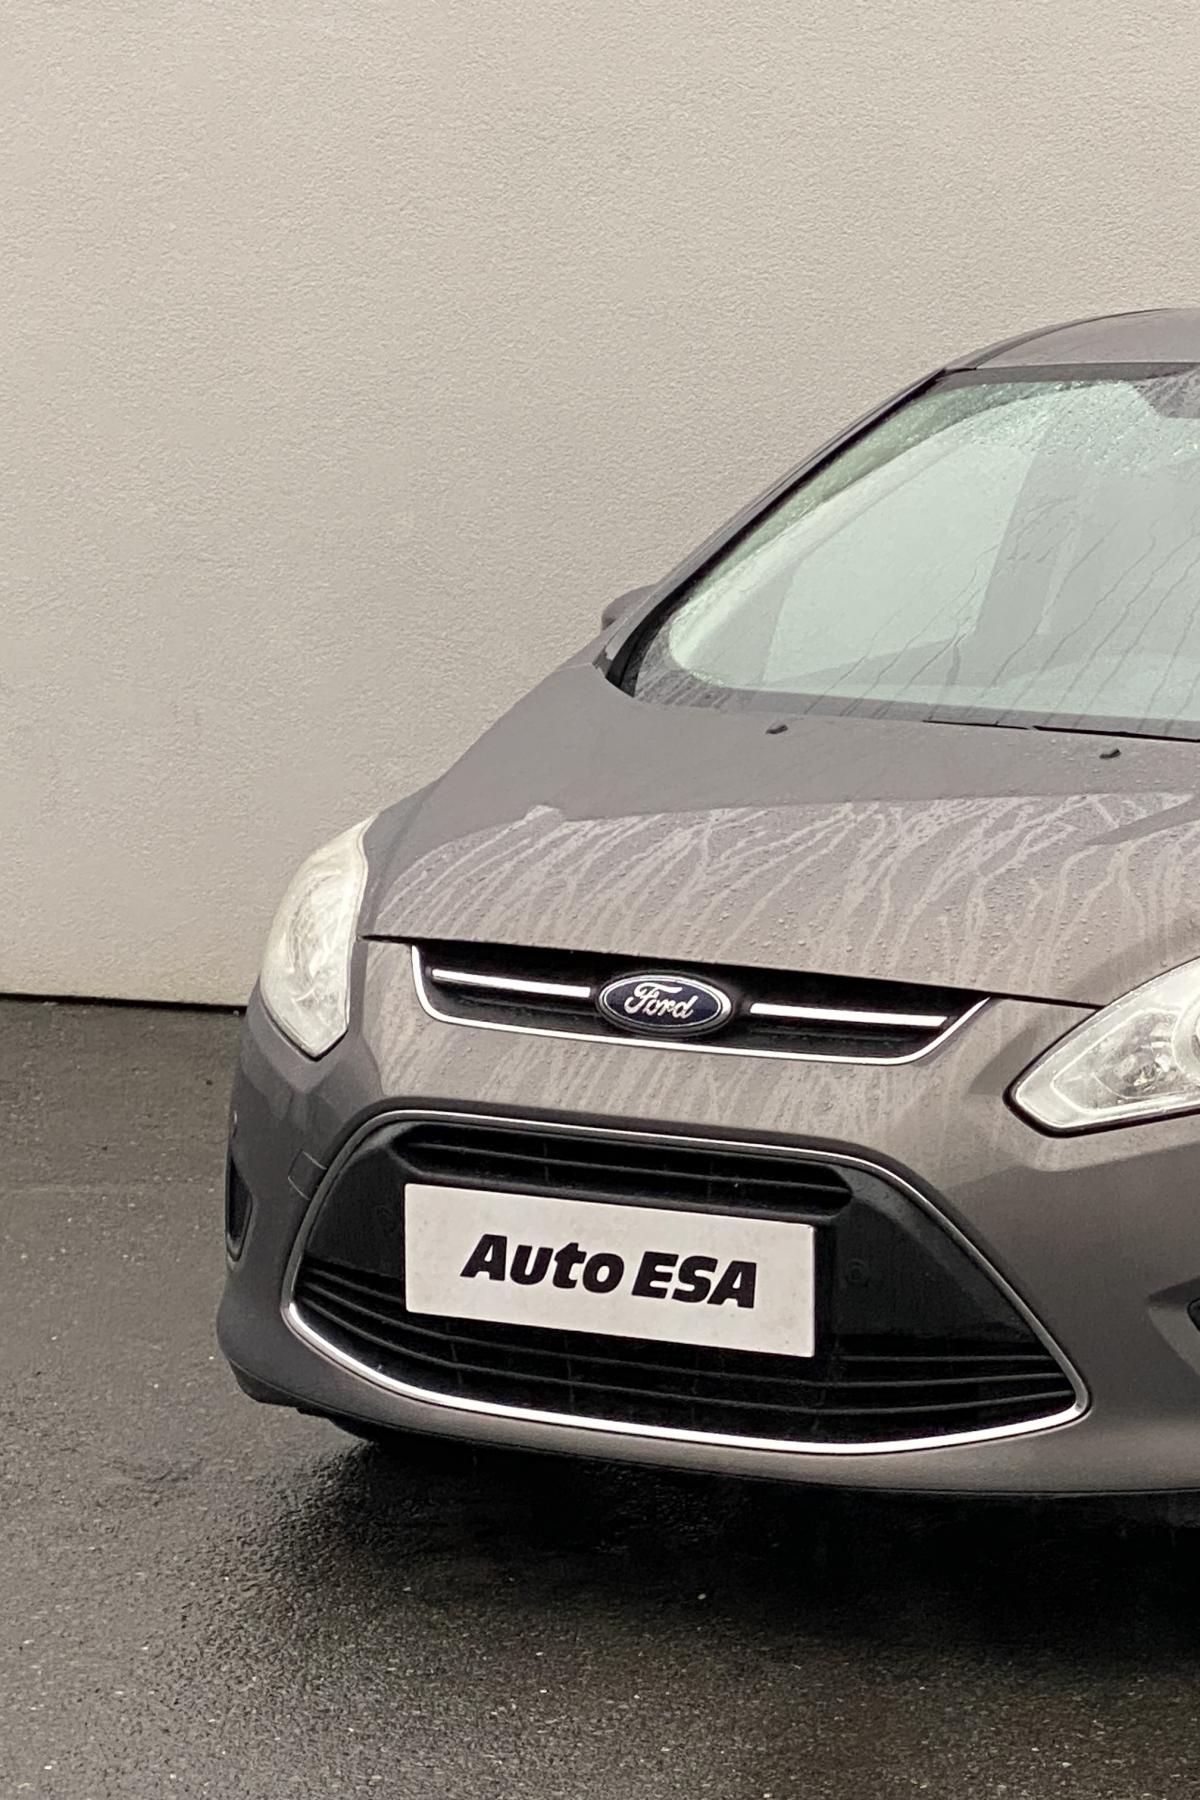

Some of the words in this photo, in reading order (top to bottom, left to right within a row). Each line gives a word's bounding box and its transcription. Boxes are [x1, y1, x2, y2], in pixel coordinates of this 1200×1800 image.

[624, 982, 698, 1019] Ford
[460, 1233, 625, 1294] Auto
[631, 1251, 757, 1309] ESA
